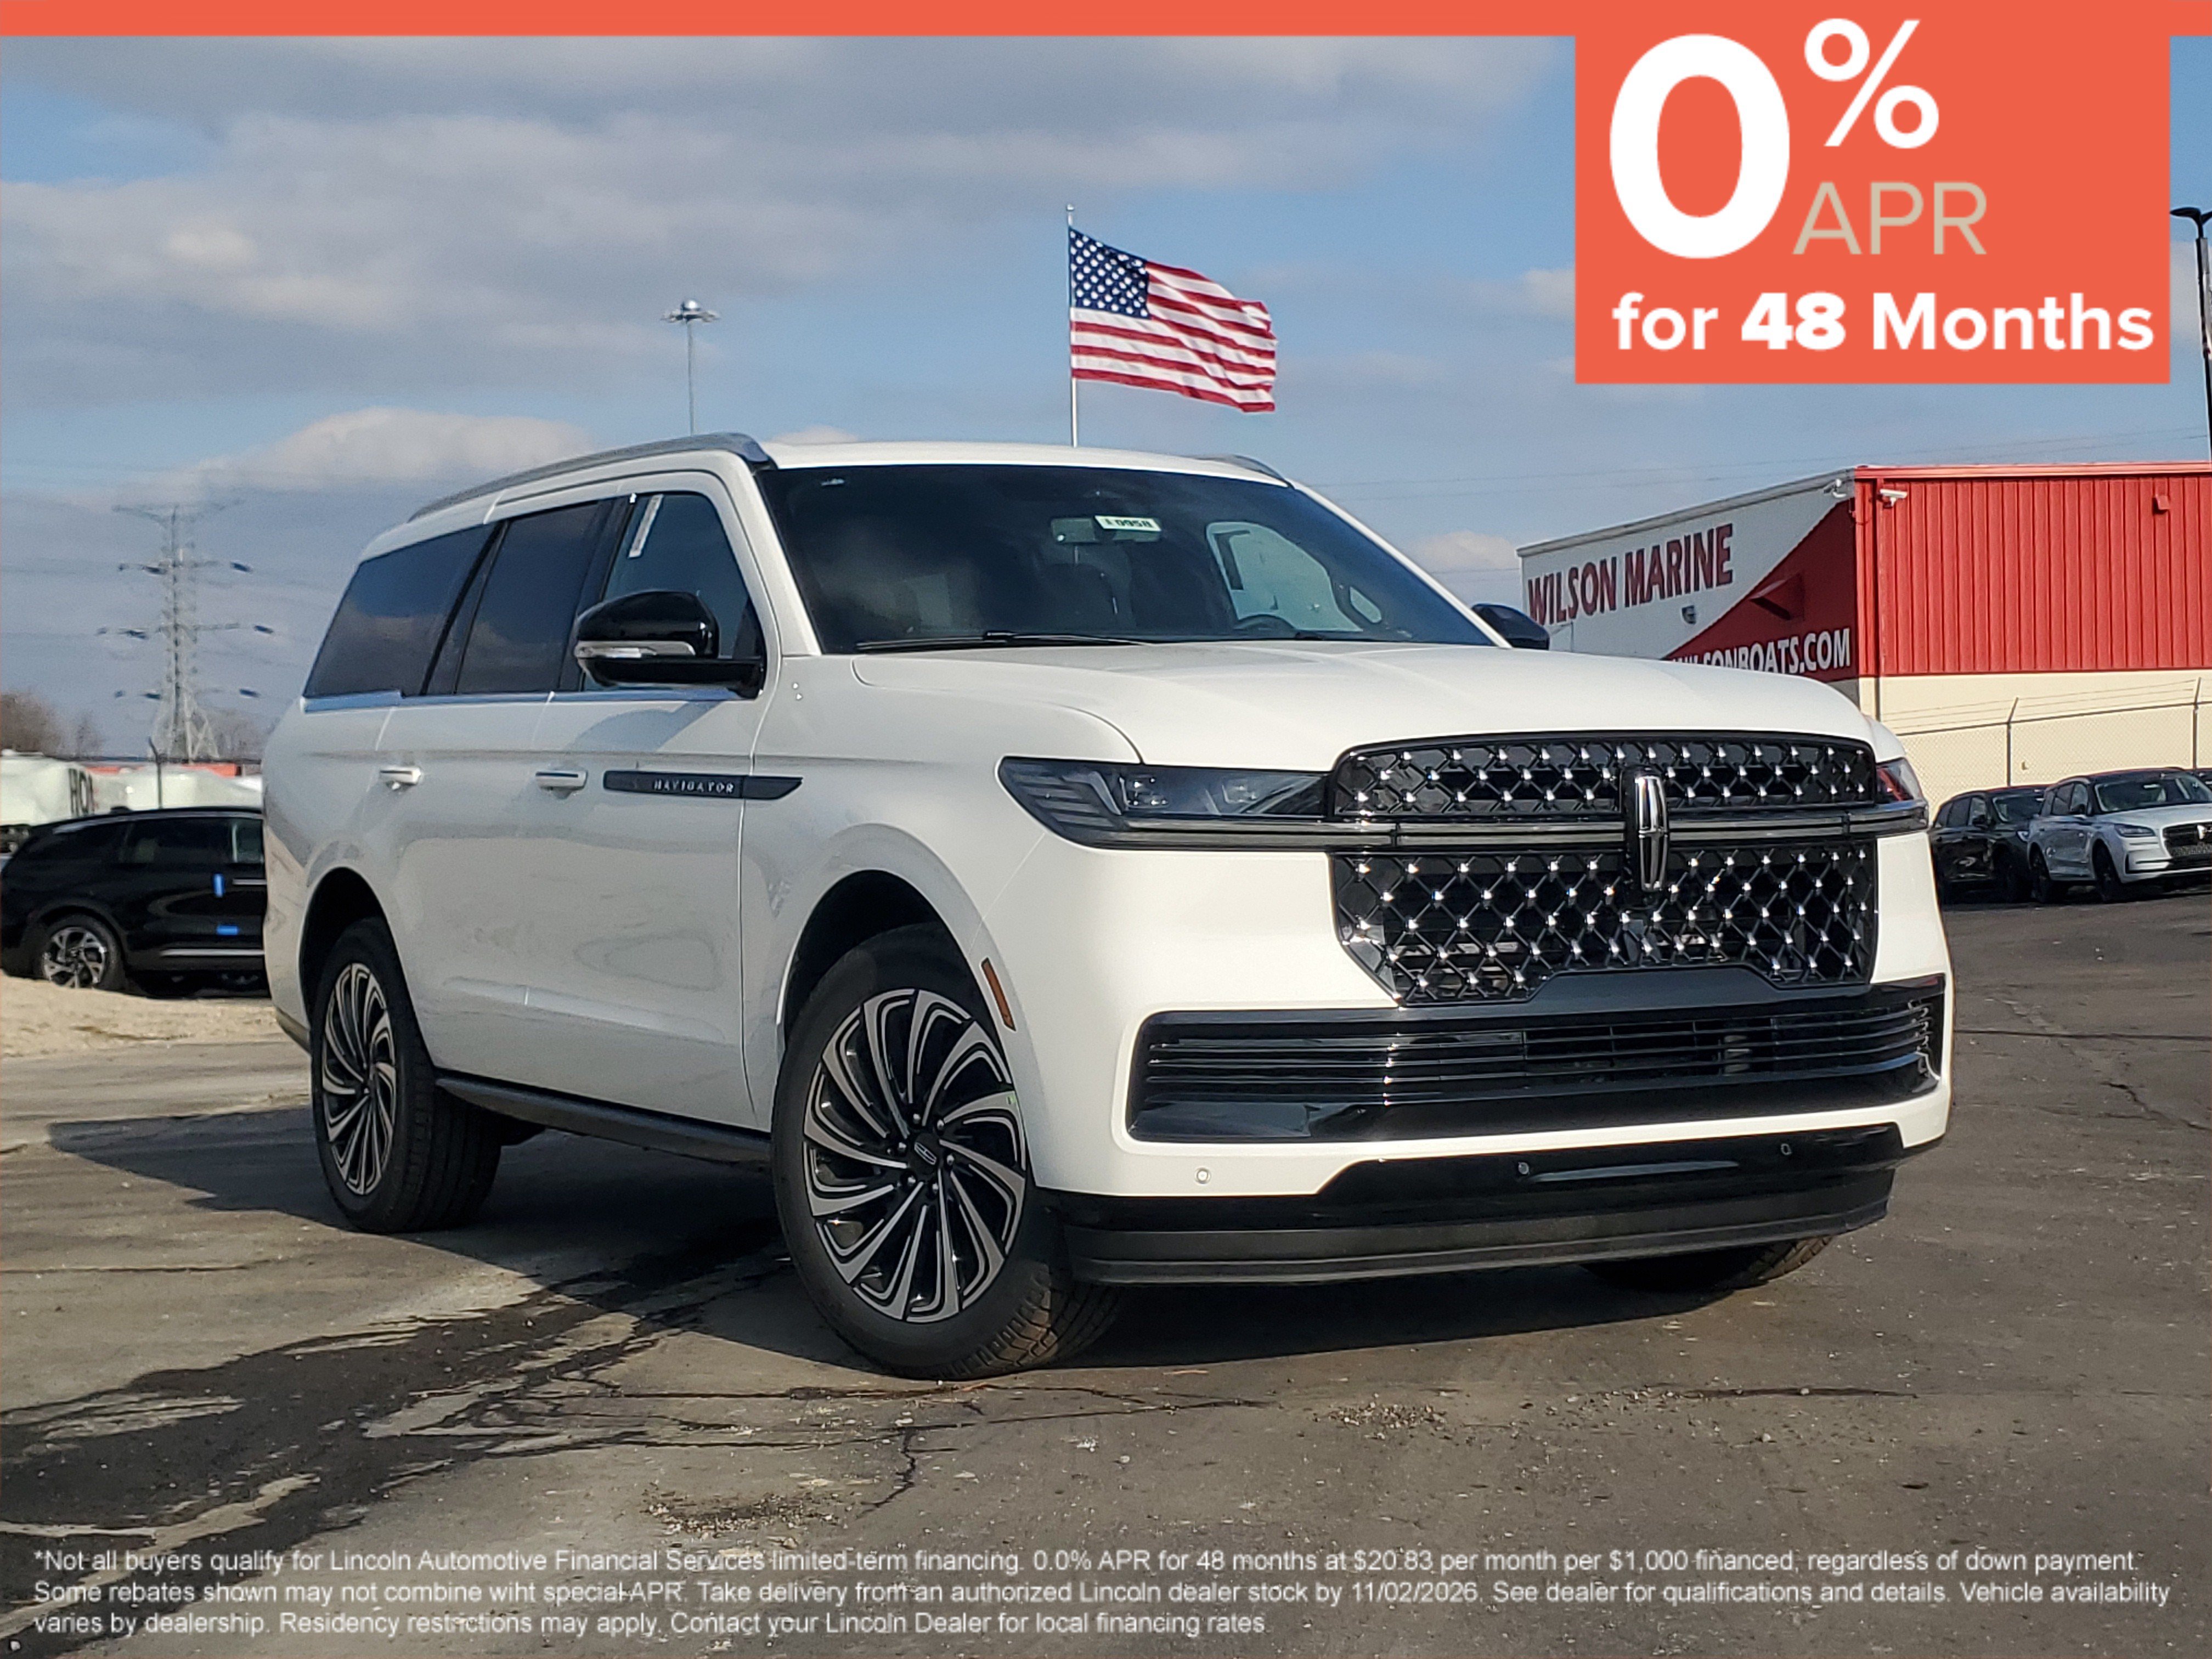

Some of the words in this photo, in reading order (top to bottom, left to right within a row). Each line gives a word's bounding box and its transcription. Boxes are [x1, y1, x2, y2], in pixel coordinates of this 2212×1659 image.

[1528, 556, 1617, 625] WILSON
[1624, 522, 1733, 608] MARINE
[653, 778, 734, 794] NAVIGATOR
